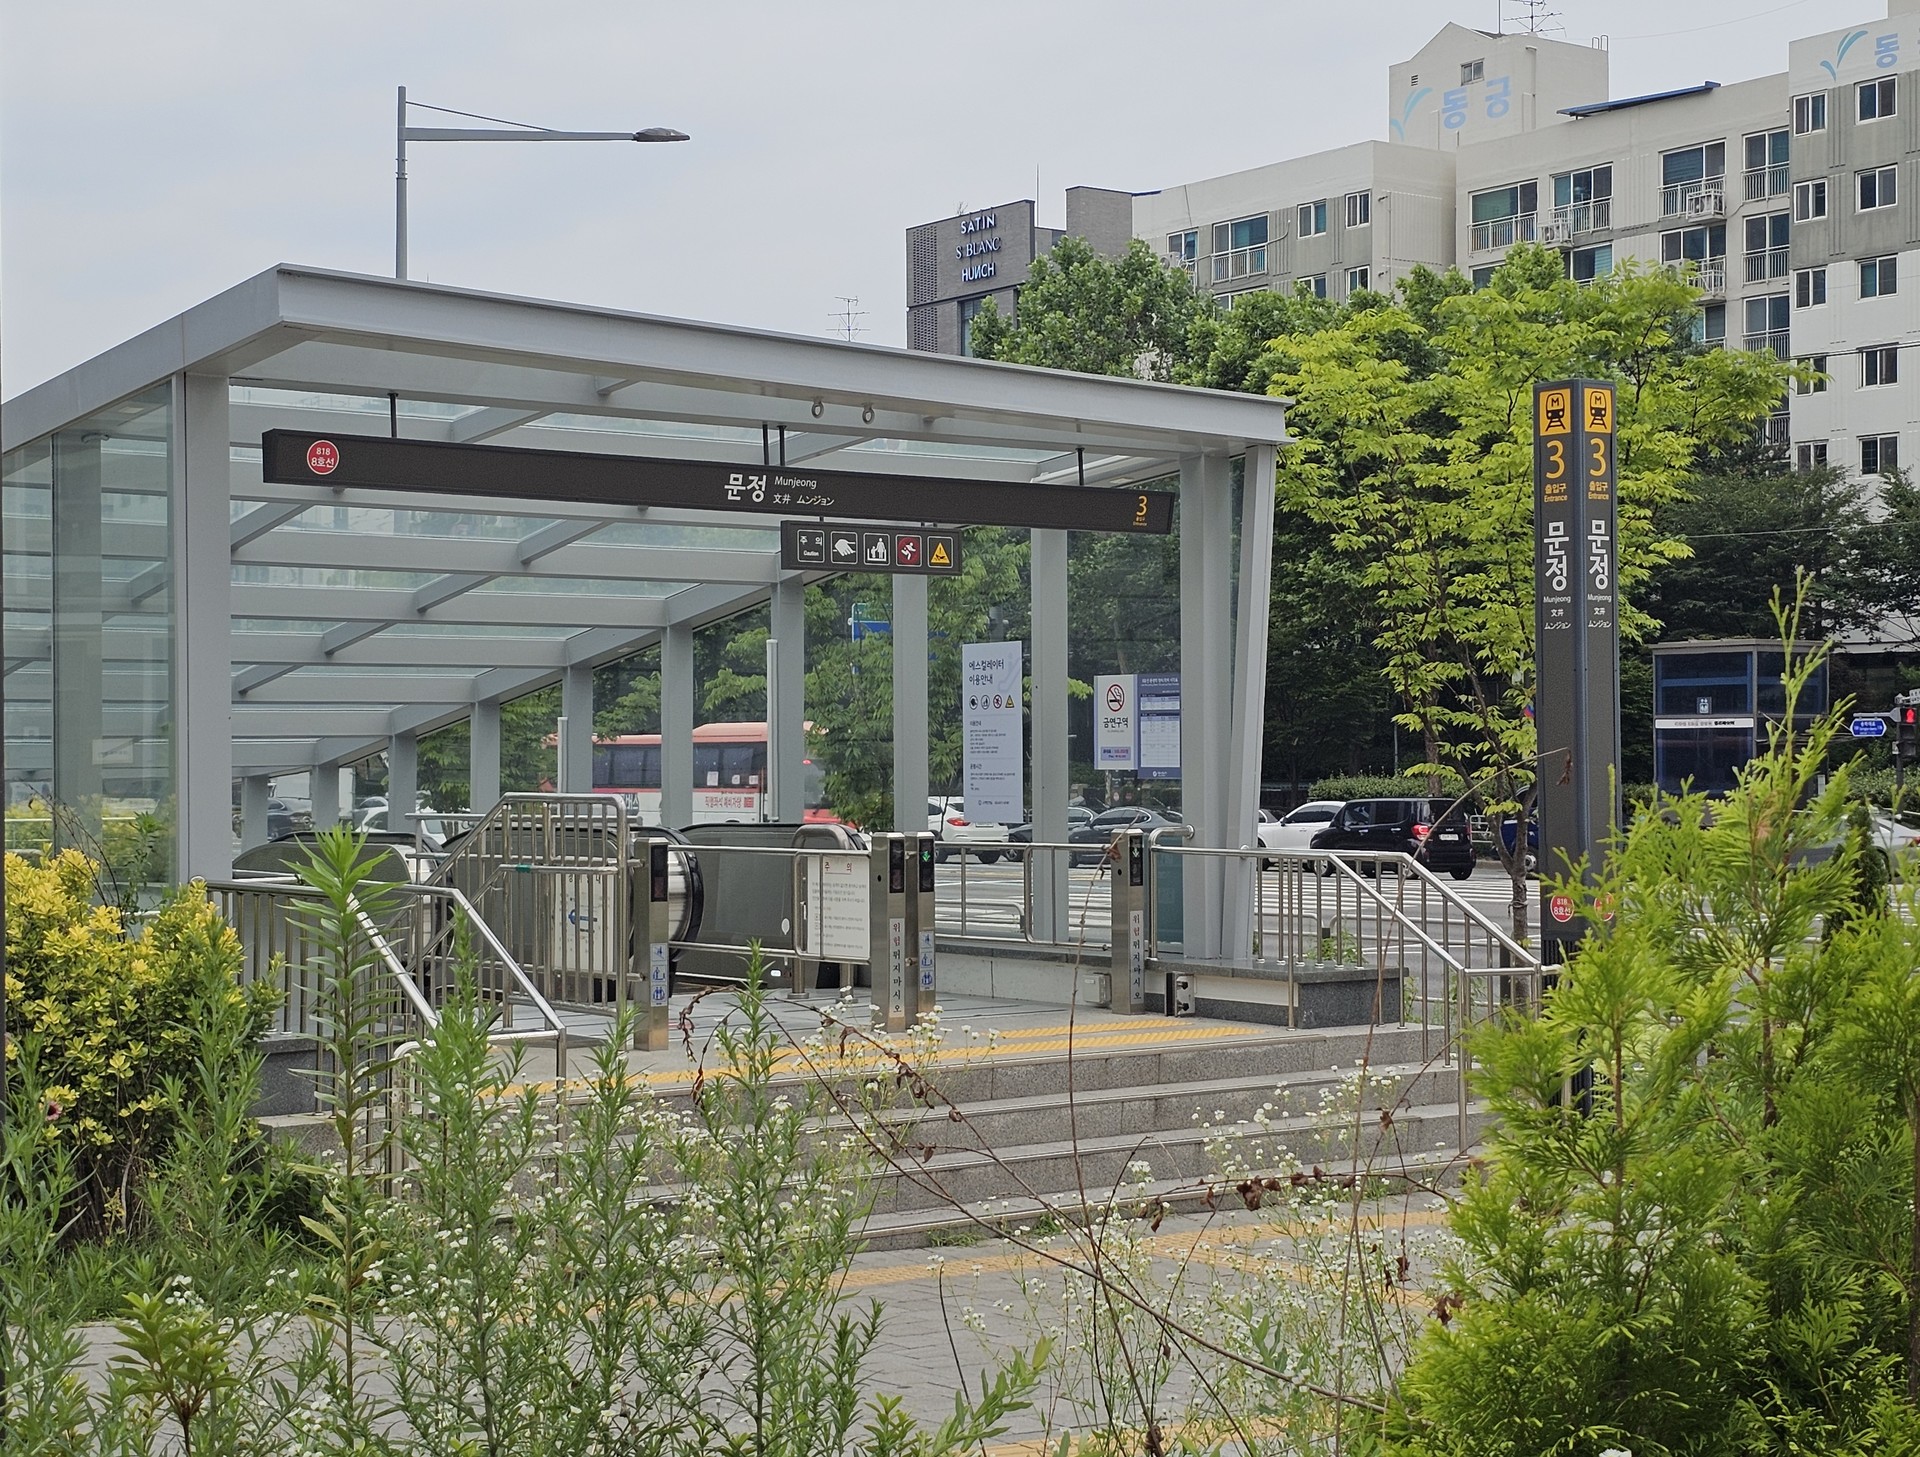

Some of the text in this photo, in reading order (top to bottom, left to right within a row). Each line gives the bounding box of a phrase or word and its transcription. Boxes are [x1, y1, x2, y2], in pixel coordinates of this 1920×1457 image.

[960, 213, 996, 234] SATIN
[956, 236, 1001, 260] S BLANC
[316, 447, 331, 456] 818
[1589, 437, 1606, 477] 3
[311, 457, 335, 468] 8호선
[1545, 440, 1565, 479] 3
[724, 473, 767, 503] 문정
[774, 475, 817, 490] Munjeong
[1544, 483, 1567, 494] 출입구
[1589, 481, 1609, 491] 출입구
[773, 493, 791, 505] 文井
[1544, 494, 1568, 503] Entrance
[1588, 491, 1609, 500] Entrance
[1135, 495, 1148, 516] 3
[1543, 521, 1570, 591] 문정
[1587, 519, 1610, 590] 문정
[1543, 595, 1572, 604] Munjeong
[1587, 593, 1612, 603] Munjeong
[968, 658, 1005, 671] 에스컬레이터
[968, 673, 993, 686] 이용안내
